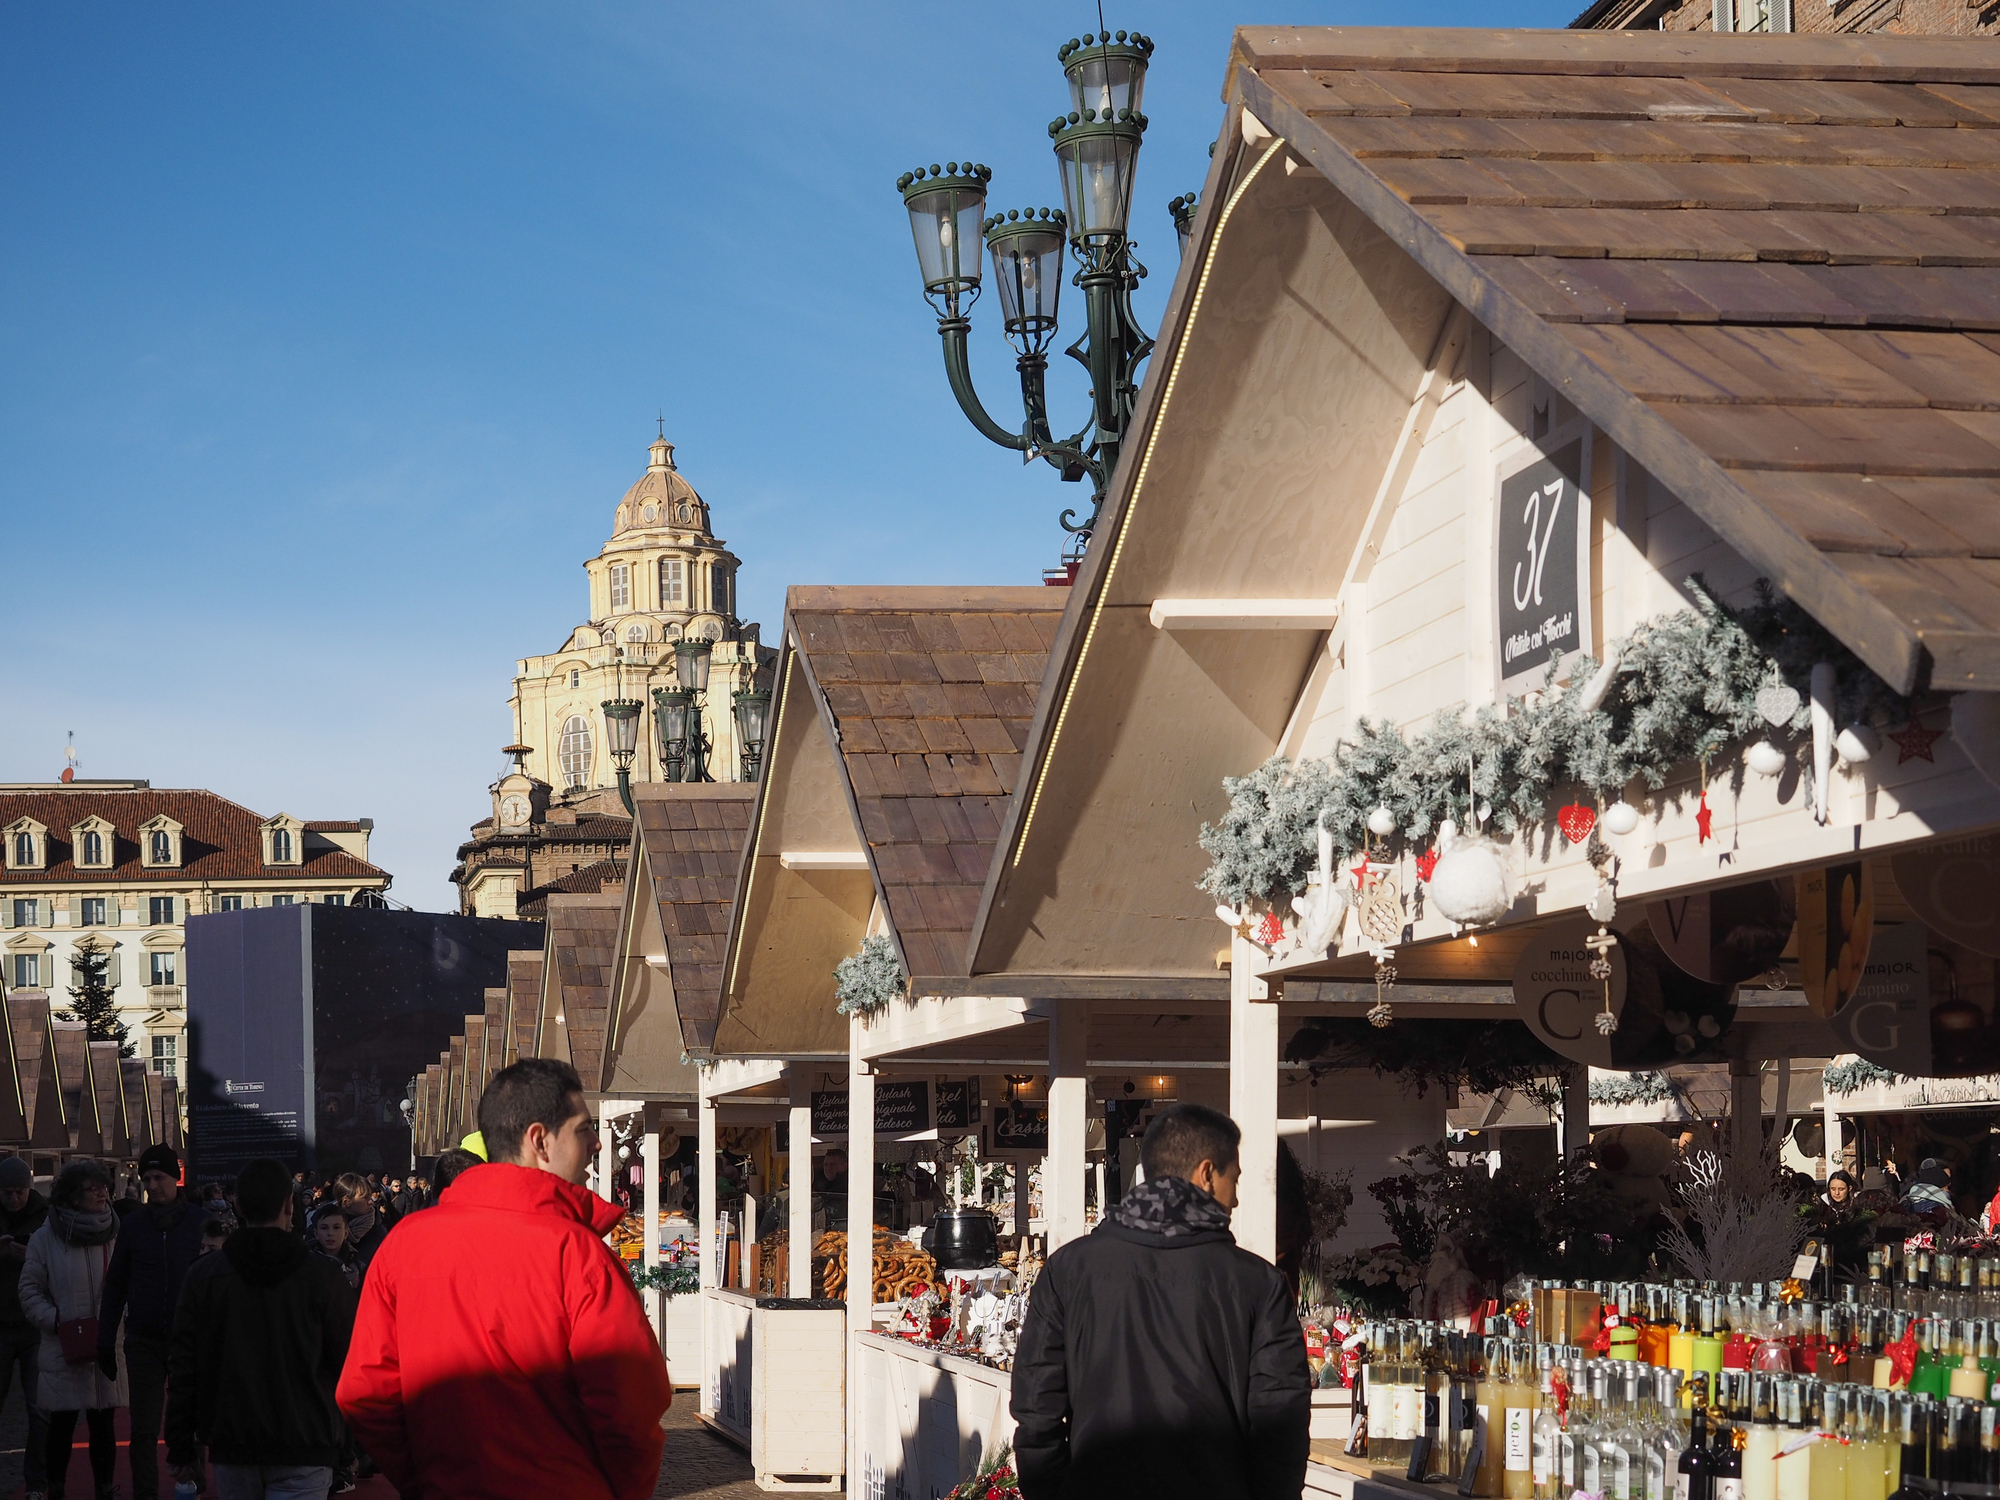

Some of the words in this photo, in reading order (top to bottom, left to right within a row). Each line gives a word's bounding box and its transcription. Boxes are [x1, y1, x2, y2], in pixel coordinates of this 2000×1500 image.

[1513, 478, 1564, 611] 37
[1505, 630, 1531, 663] Natale
[1665, 896, 1690, 943] V
[1550, 950, 1595, 963] MAJOR
[1531, 967, 1591, 982] cocchino
[1864, 962, 1920, 976] MAJOR
[1853, 981, 1909, 999] rappino
[1538, 989, 1582, 1040] C
[1849, 1001, 1901, 1052] G
[875, 1086, 912, 1104] Gulash
[935, 1087, 962, 1107] ezel
[814, 1109, 849, 1121] origina
[875, 1101, 917, 1118] riginale
[936, 1109, 958, 1124] ldo
[818, 1121, 849, 1131] tedesc
[875, 1117, 913, 1129] tedesco
